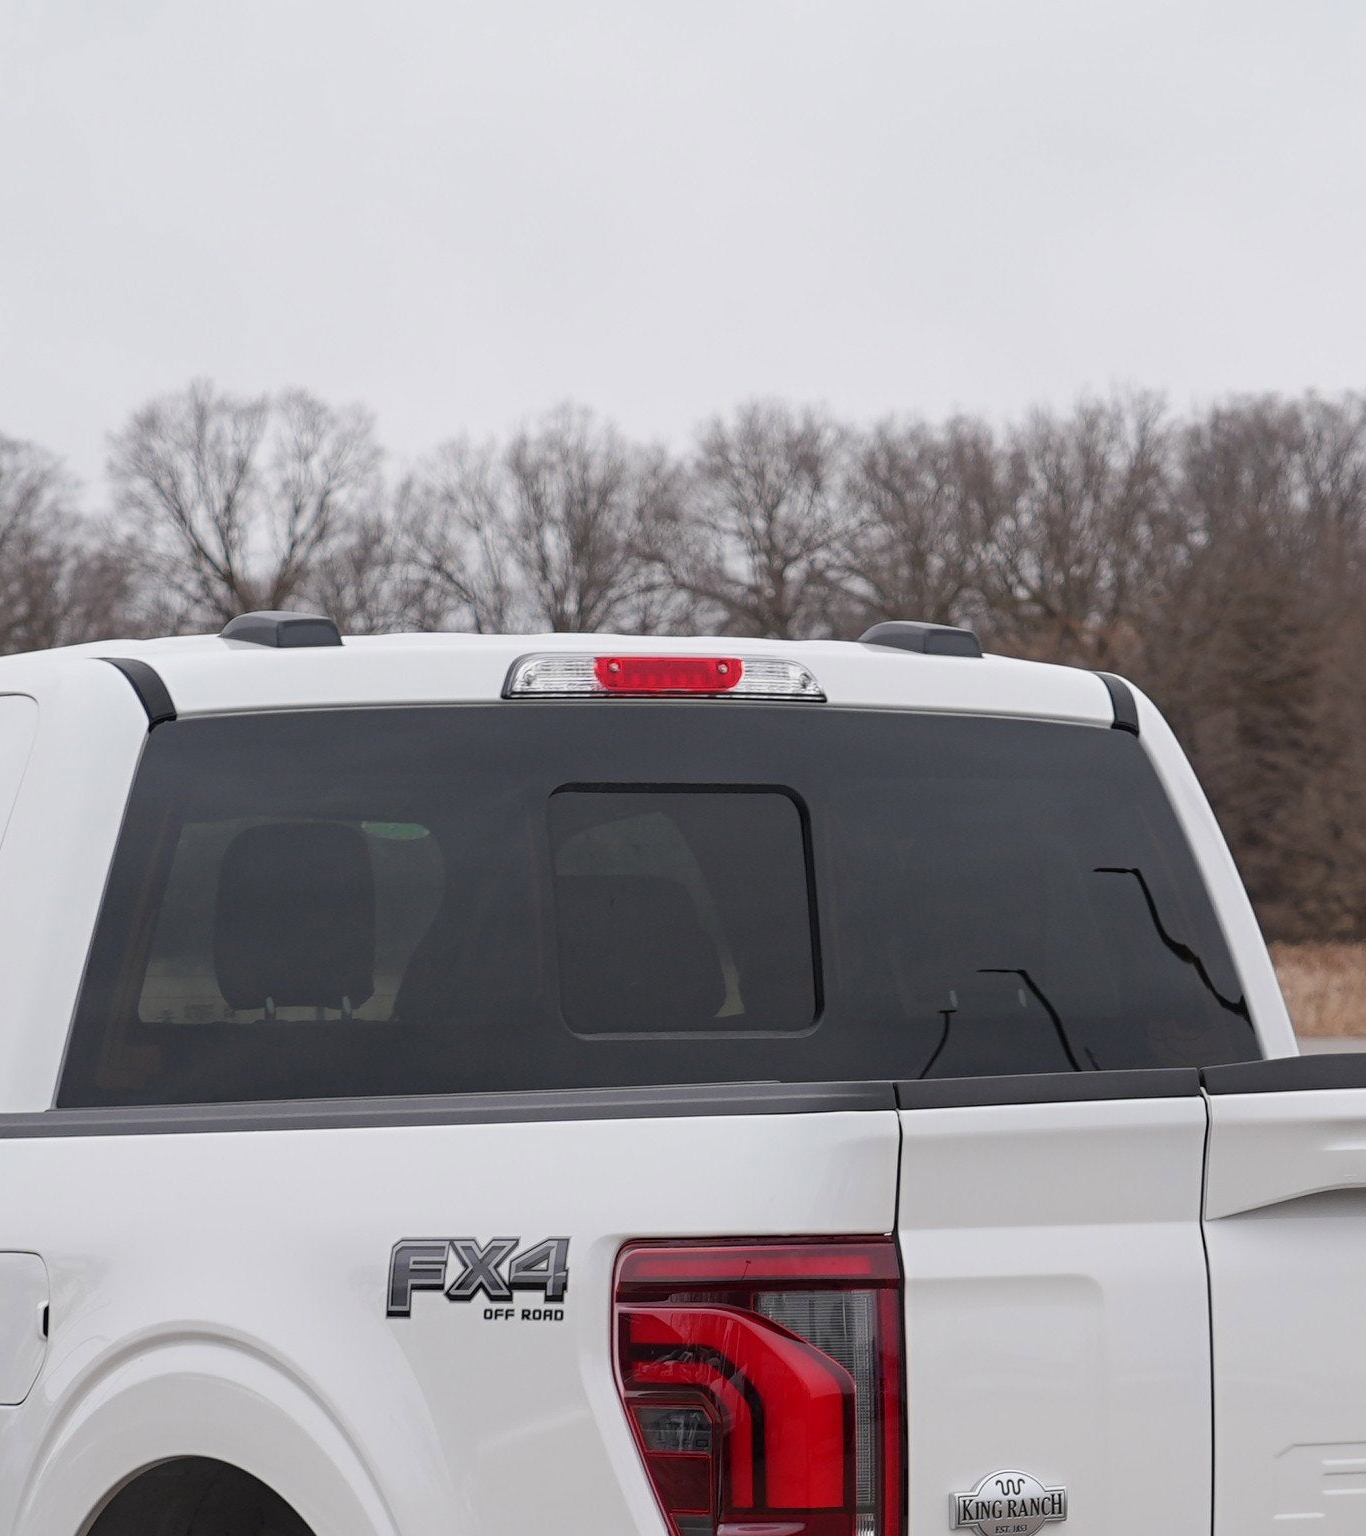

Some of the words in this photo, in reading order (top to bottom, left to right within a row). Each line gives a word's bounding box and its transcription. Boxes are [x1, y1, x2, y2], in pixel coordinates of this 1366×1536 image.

[386, 1236, 571, 1318] FX4
[484, 1308, 515, 1320] OFF
[521, 1308, 564, 1321] ROAD
[962, 1499, 1002, 1521] KING
[1007, 1493, 1063, 1518] RANCH
